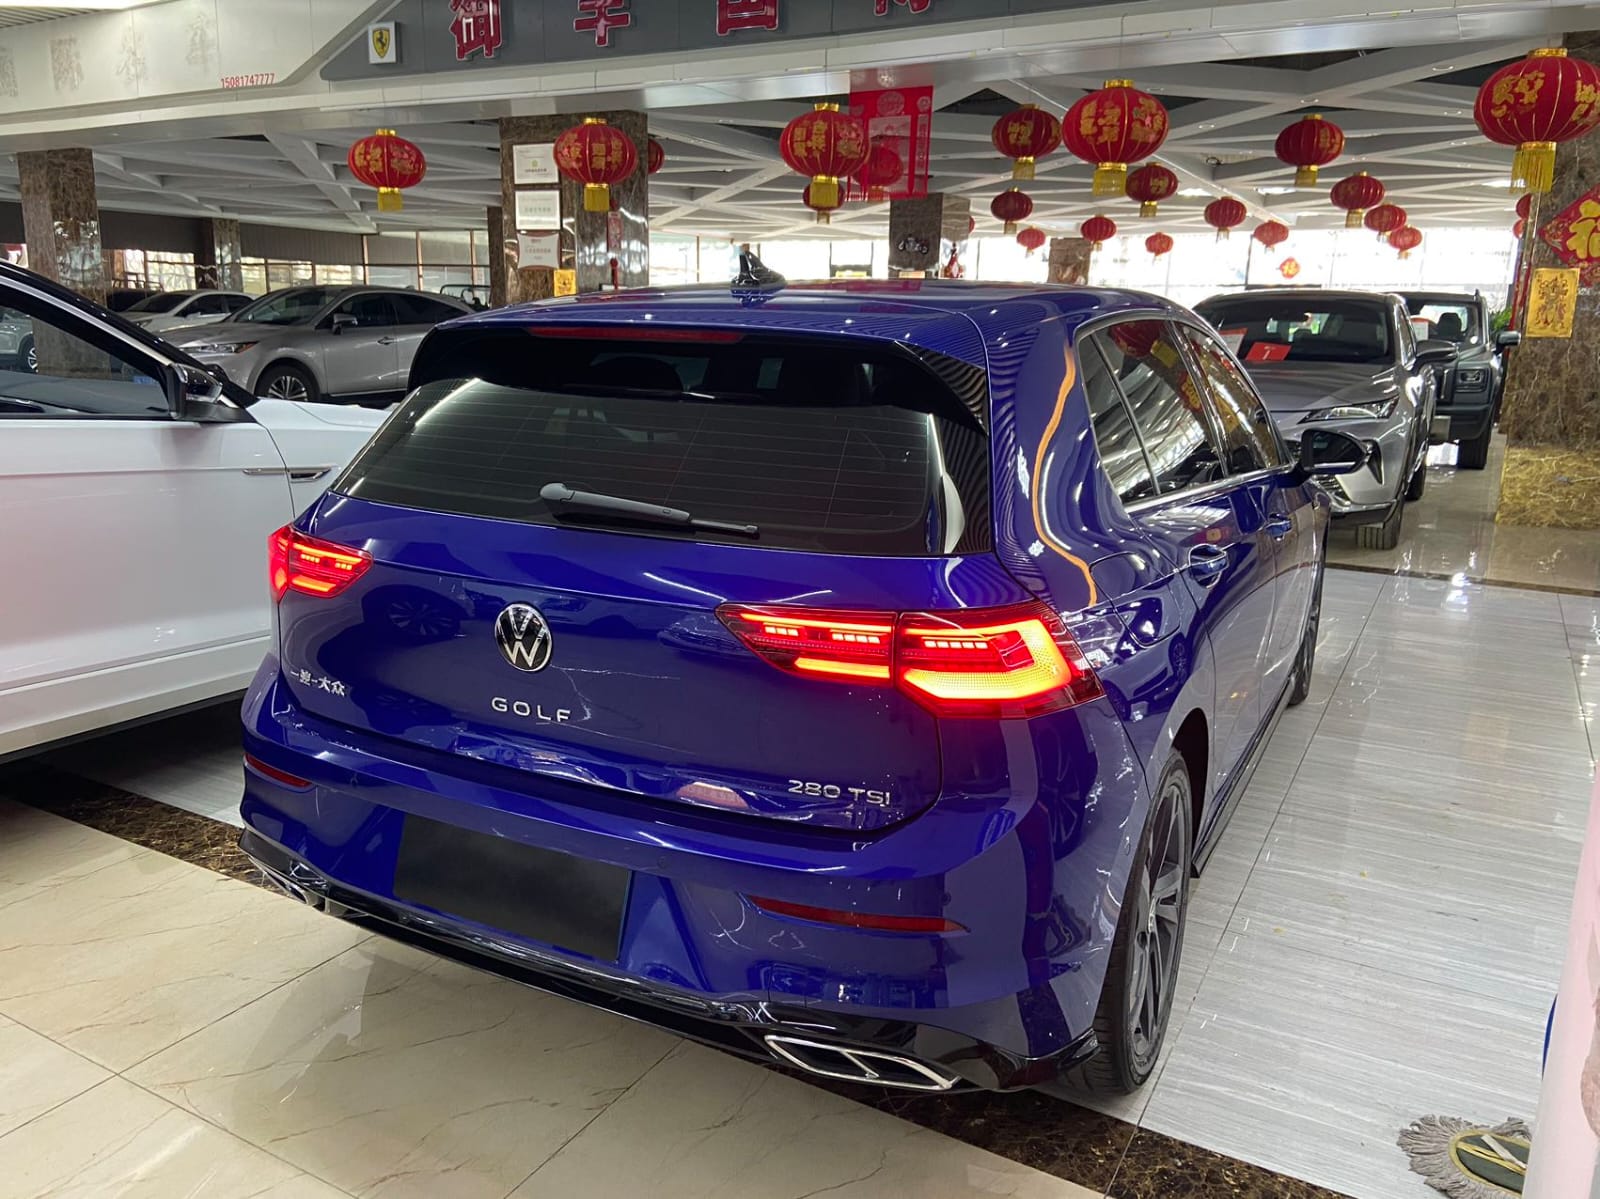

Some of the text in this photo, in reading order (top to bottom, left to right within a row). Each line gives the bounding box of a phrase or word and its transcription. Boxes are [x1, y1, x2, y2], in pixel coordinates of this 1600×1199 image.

[220, 72, 275, 89] 15081747777
[491, 697, 571, 722] GOLF
[788, 779, 890, 805] 280 TSI
